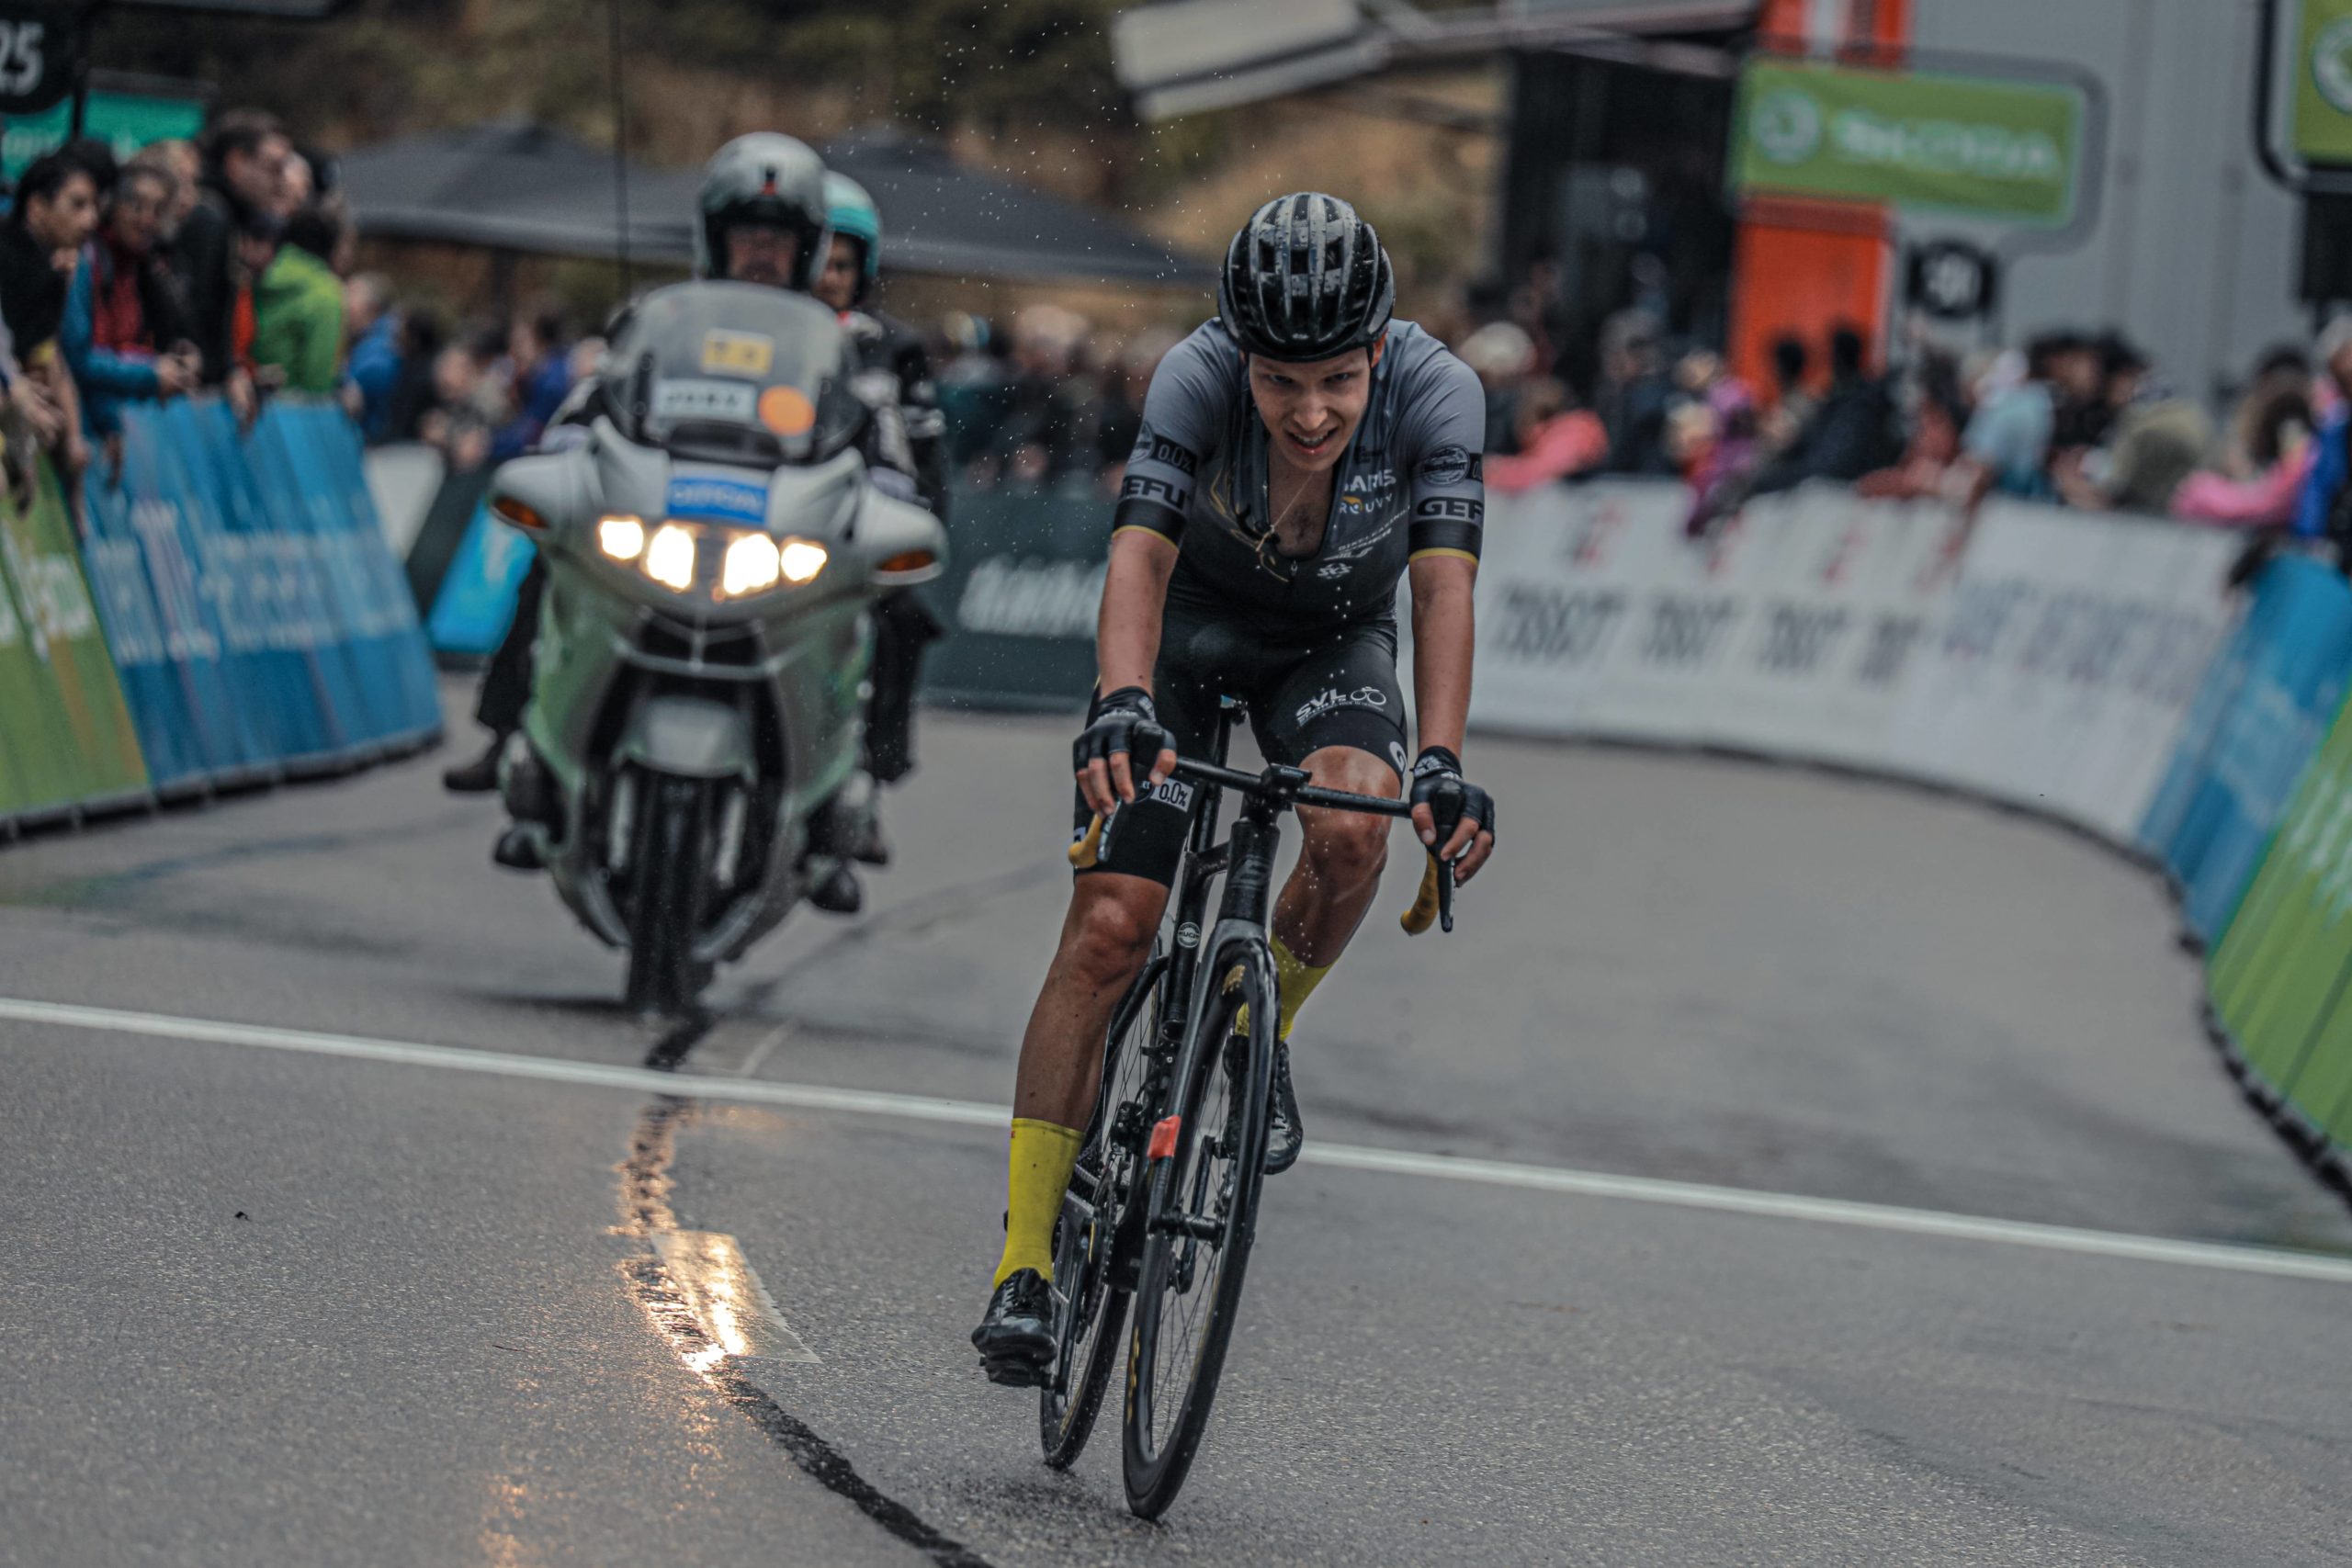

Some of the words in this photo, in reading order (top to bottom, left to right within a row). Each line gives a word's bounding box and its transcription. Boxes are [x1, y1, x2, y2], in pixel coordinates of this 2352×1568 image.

[1123, 476, 1186, 511] EFU
[1339, 493, 1393, 514] ROUVY
[1295, 688, 1347, 717] SVL
[1159, 782, 1188, 807] 0,0%
